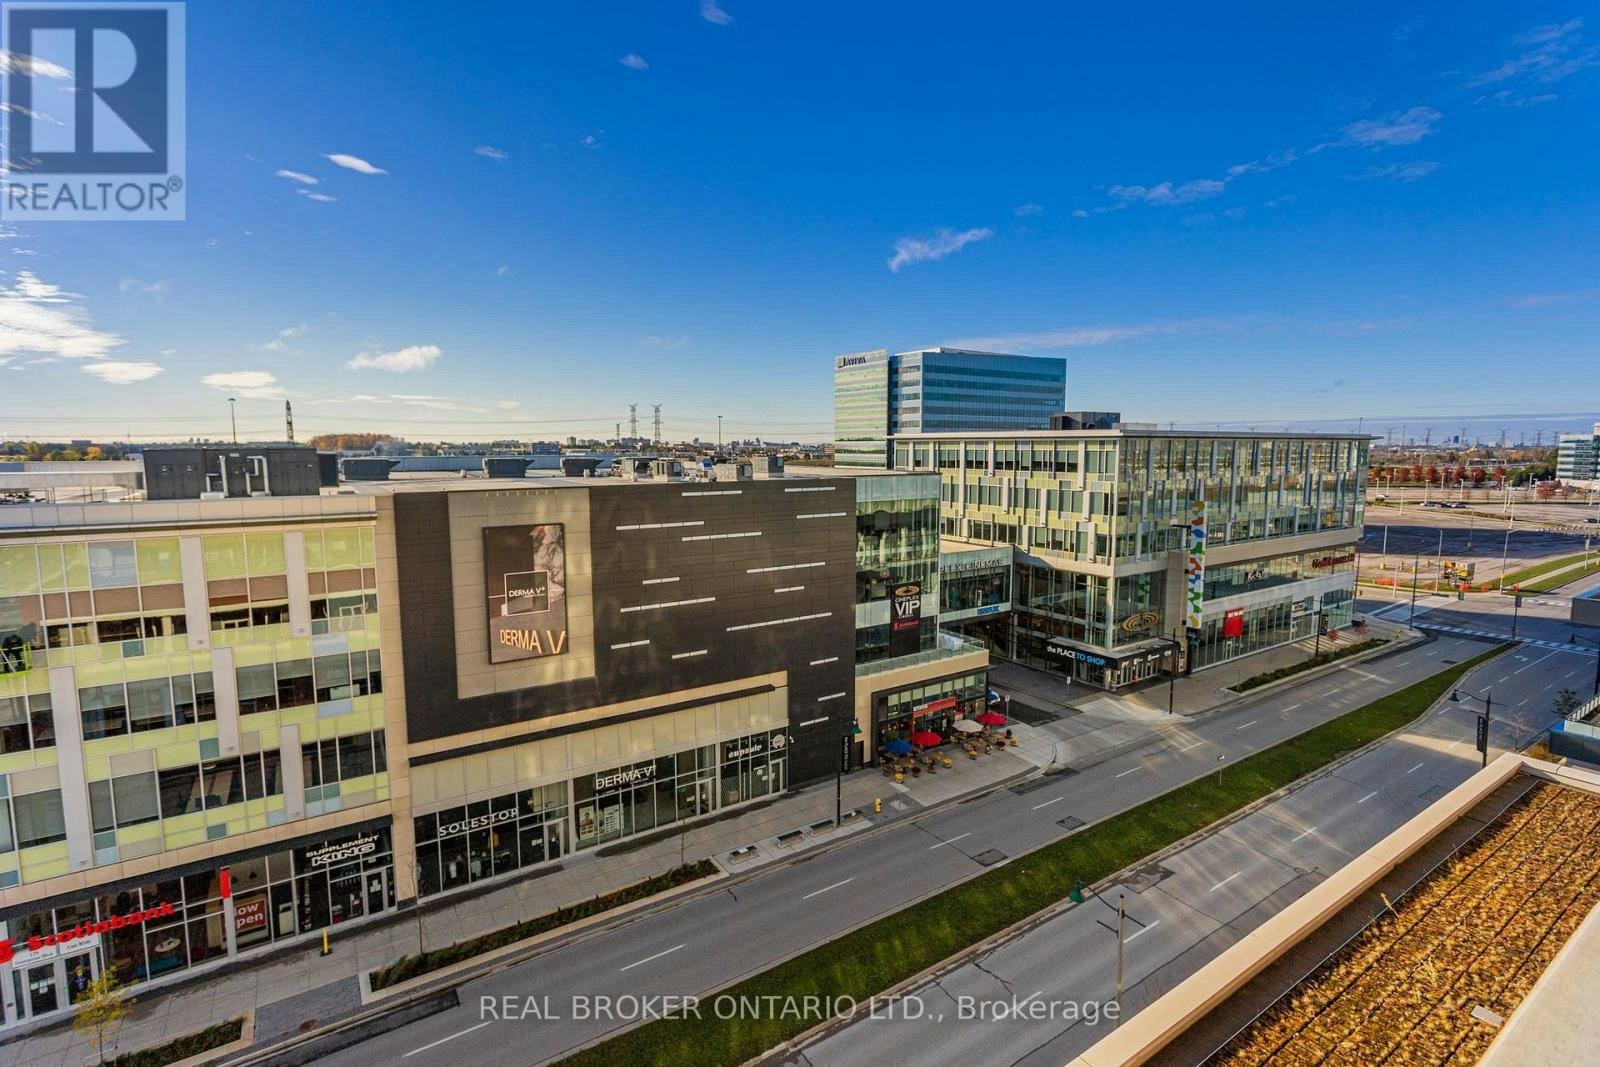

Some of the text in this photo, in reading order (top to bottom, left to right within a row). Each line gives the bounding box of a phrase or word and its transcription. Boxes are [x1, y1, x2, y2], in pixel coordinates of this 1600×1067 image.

[509, 589, 535, 597] DERMA
[895, 600, 920, 616] VIP
[500, 629, 566, 654] DERMA V
[1047, 645, 1105, 666] the PLACE TO SHOP
[595, 769, 641, 790] DERMA
[439, 807, 519, 836] SOLESTOP
[305, 834, 380, 858] SUPPLEMENT
[312, 843, 376, 866] KING
[234, 903, 260, 917] ow
[236, 913, 264, 928] pen
[28, 902, 174, 951] Scotiabank
